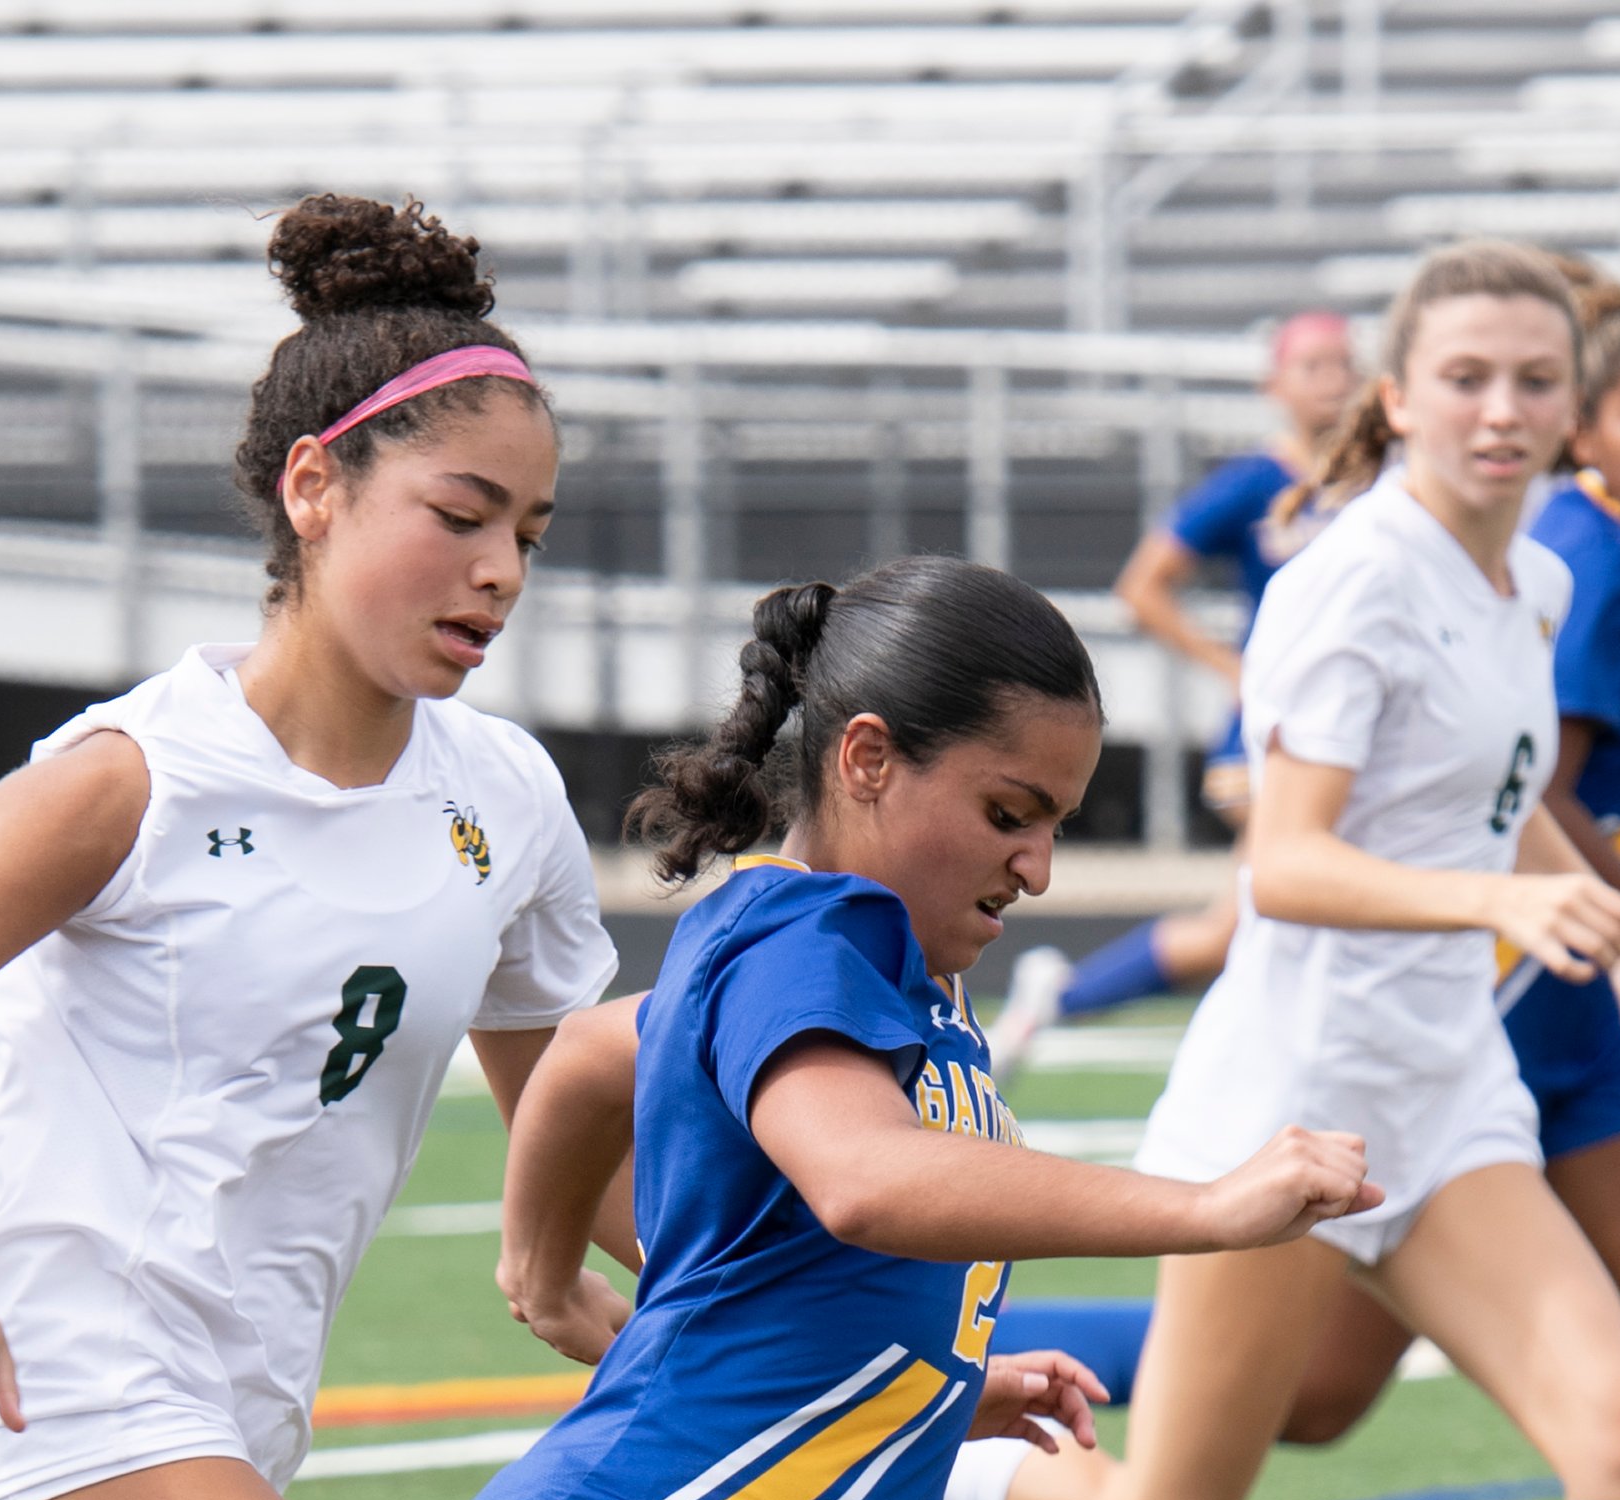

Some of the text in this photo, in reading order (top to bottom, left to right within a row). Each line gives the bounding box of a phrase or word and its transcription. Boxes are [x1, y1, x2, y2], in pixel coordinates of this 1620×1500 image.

[1490, 731, 1534, 834] 6
[320, 966, 407, 1107] 8
[952, 1260, 1005, 1371] 2
